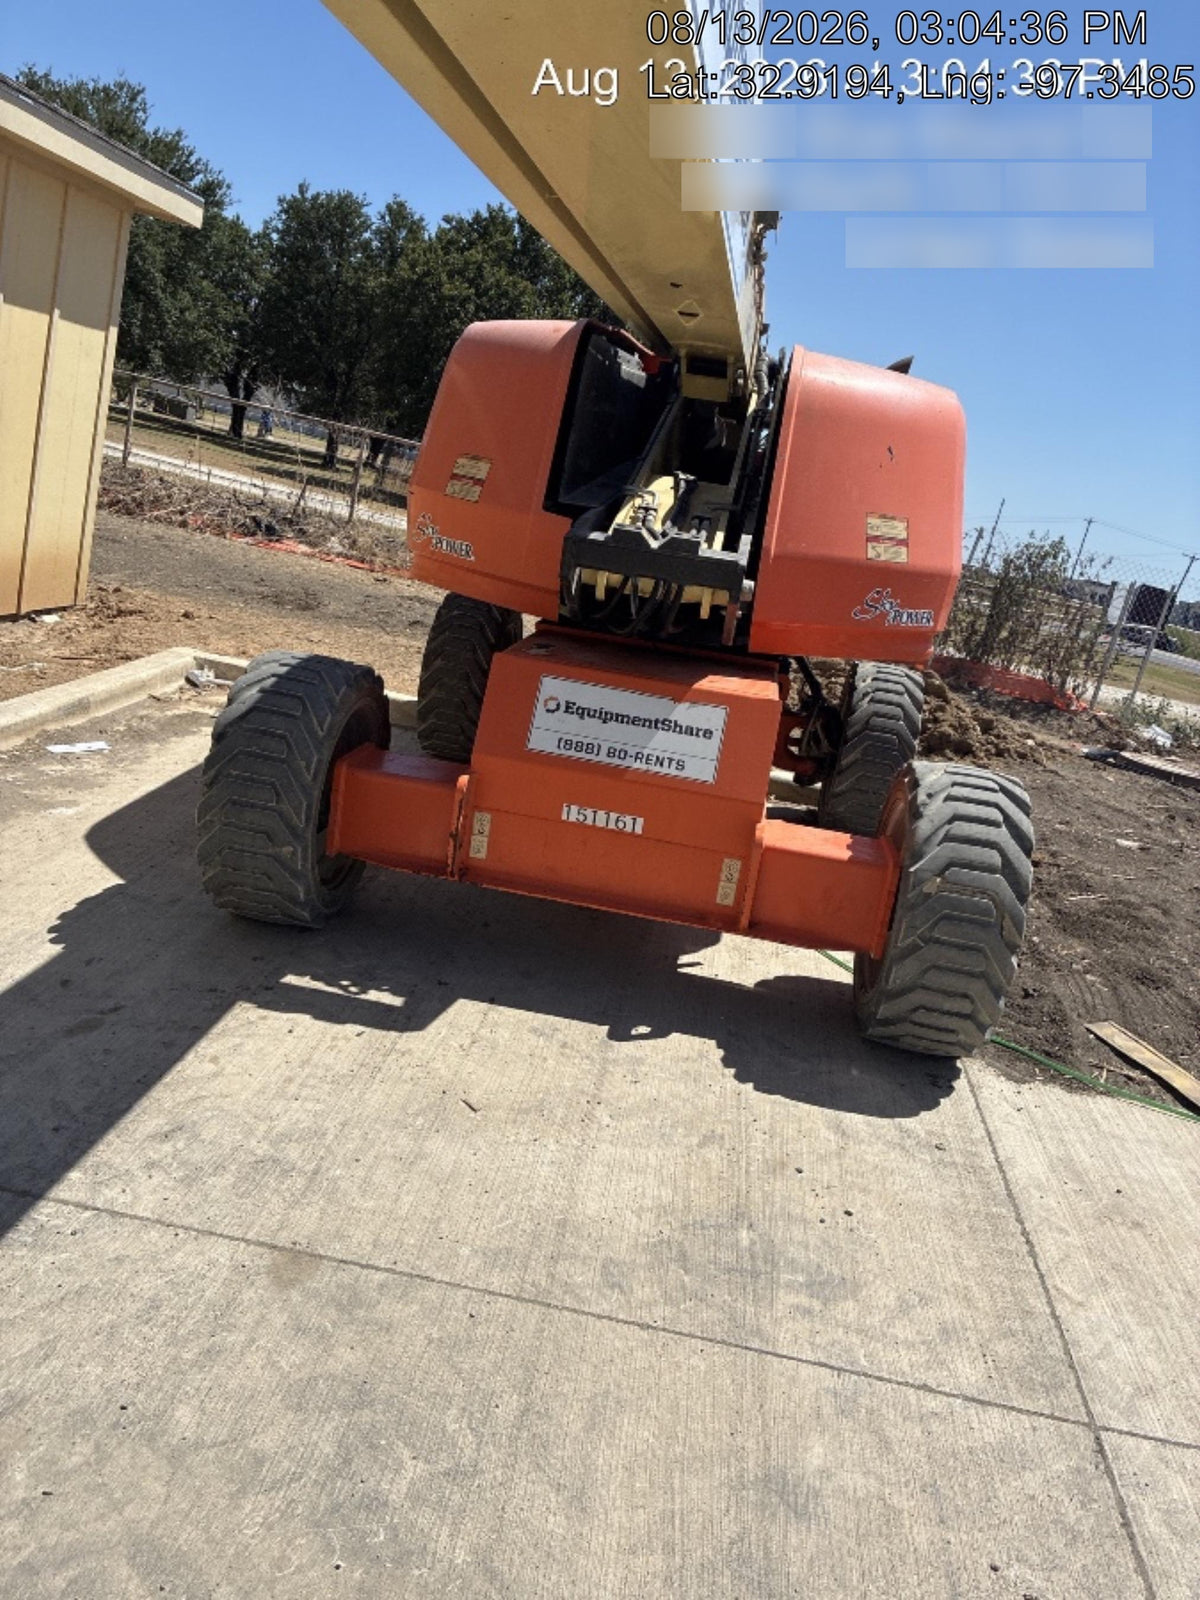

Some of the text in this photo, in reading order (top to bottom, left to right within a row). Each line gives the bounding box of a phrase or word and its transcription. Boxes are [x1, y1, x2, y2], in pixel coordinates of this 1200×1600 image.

[563, 699, 714, 740] EquipmentShare
[557, 737, 686, 772] (888) 80-RENTS
[564, 804, 637, 833] 151161
